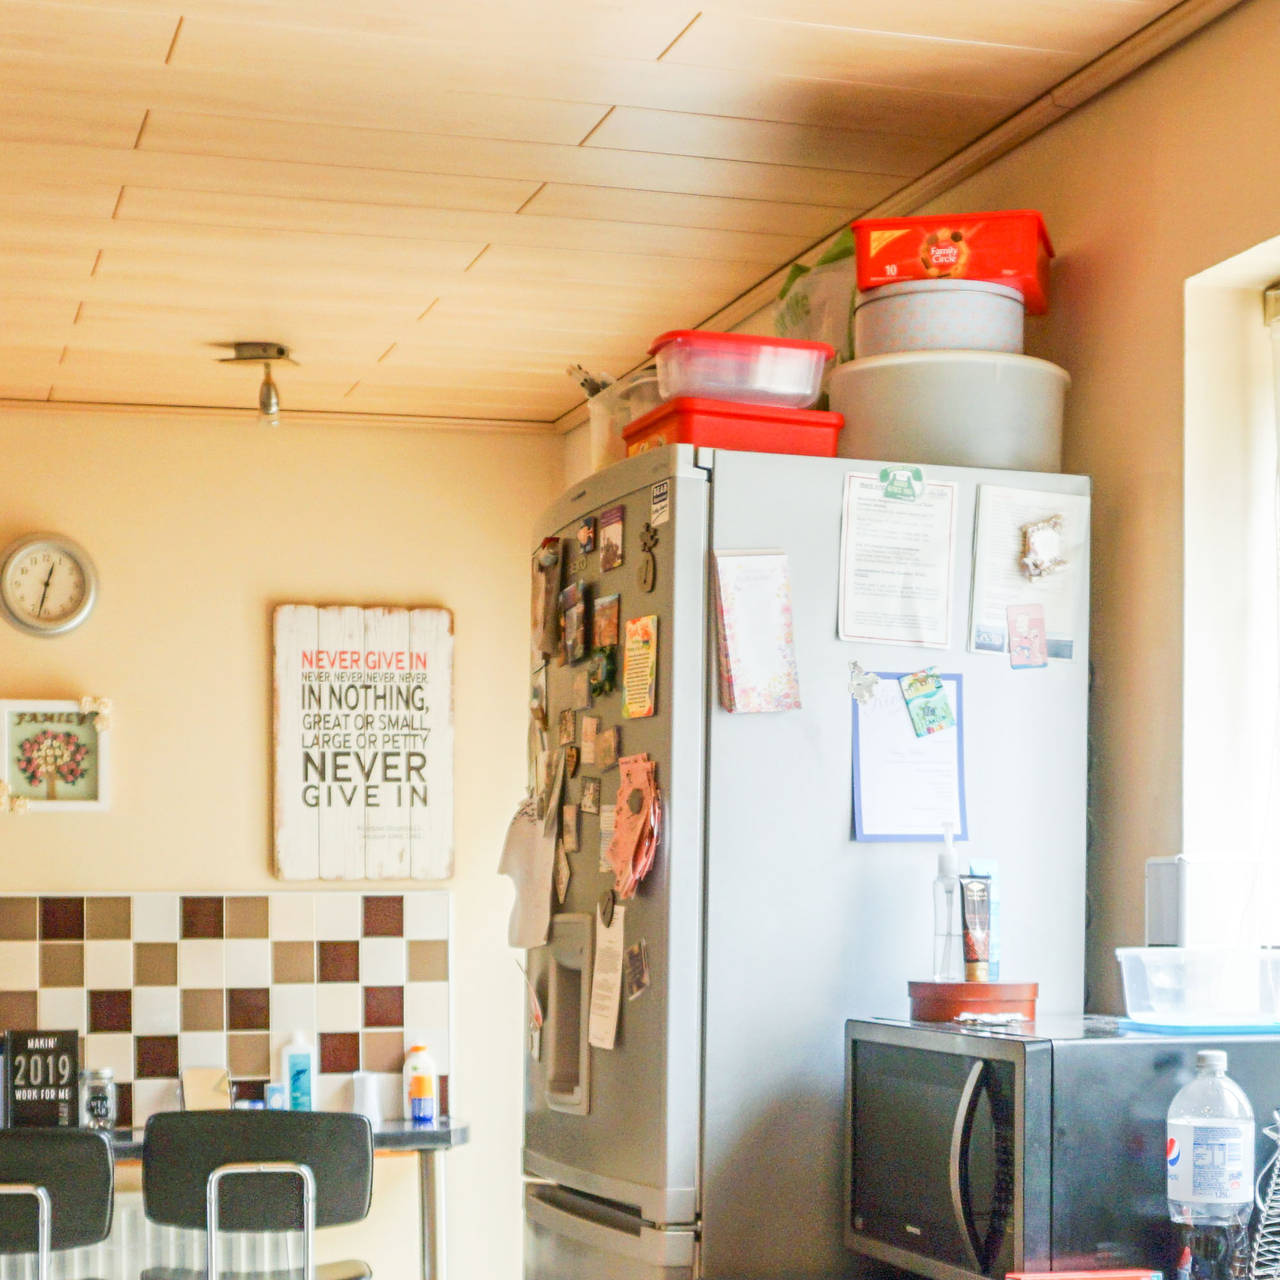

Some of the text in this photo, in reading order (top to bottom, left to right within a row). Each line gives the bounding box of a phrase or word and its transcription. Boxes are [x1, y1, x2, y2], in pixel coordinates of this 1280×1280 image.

[930, 246, 958, 257] Family
[931, 254, 957, 264] Circle
[884, 264, 898, 276] 10
[301, 650, 427, 670] NEVER GIVE IN
[301, 683, 429, 714] IN NOTHING,
[15, 712, 87, 727] FAMILY
[302, 713, 350, 730] GREAT
[354, 713, 375, 731] OR
[301, 733, 428, 749] LARGE OR PETTY
[303, 751, 427, 783] NEVER
[302, 785, 428, 807] GIVE IN
[27, 1037, 57, 1049] MAKIN'
[14, 1054, 70, 1085] 2019
[15, 1088, 69, 1100] WORK FOR ME
